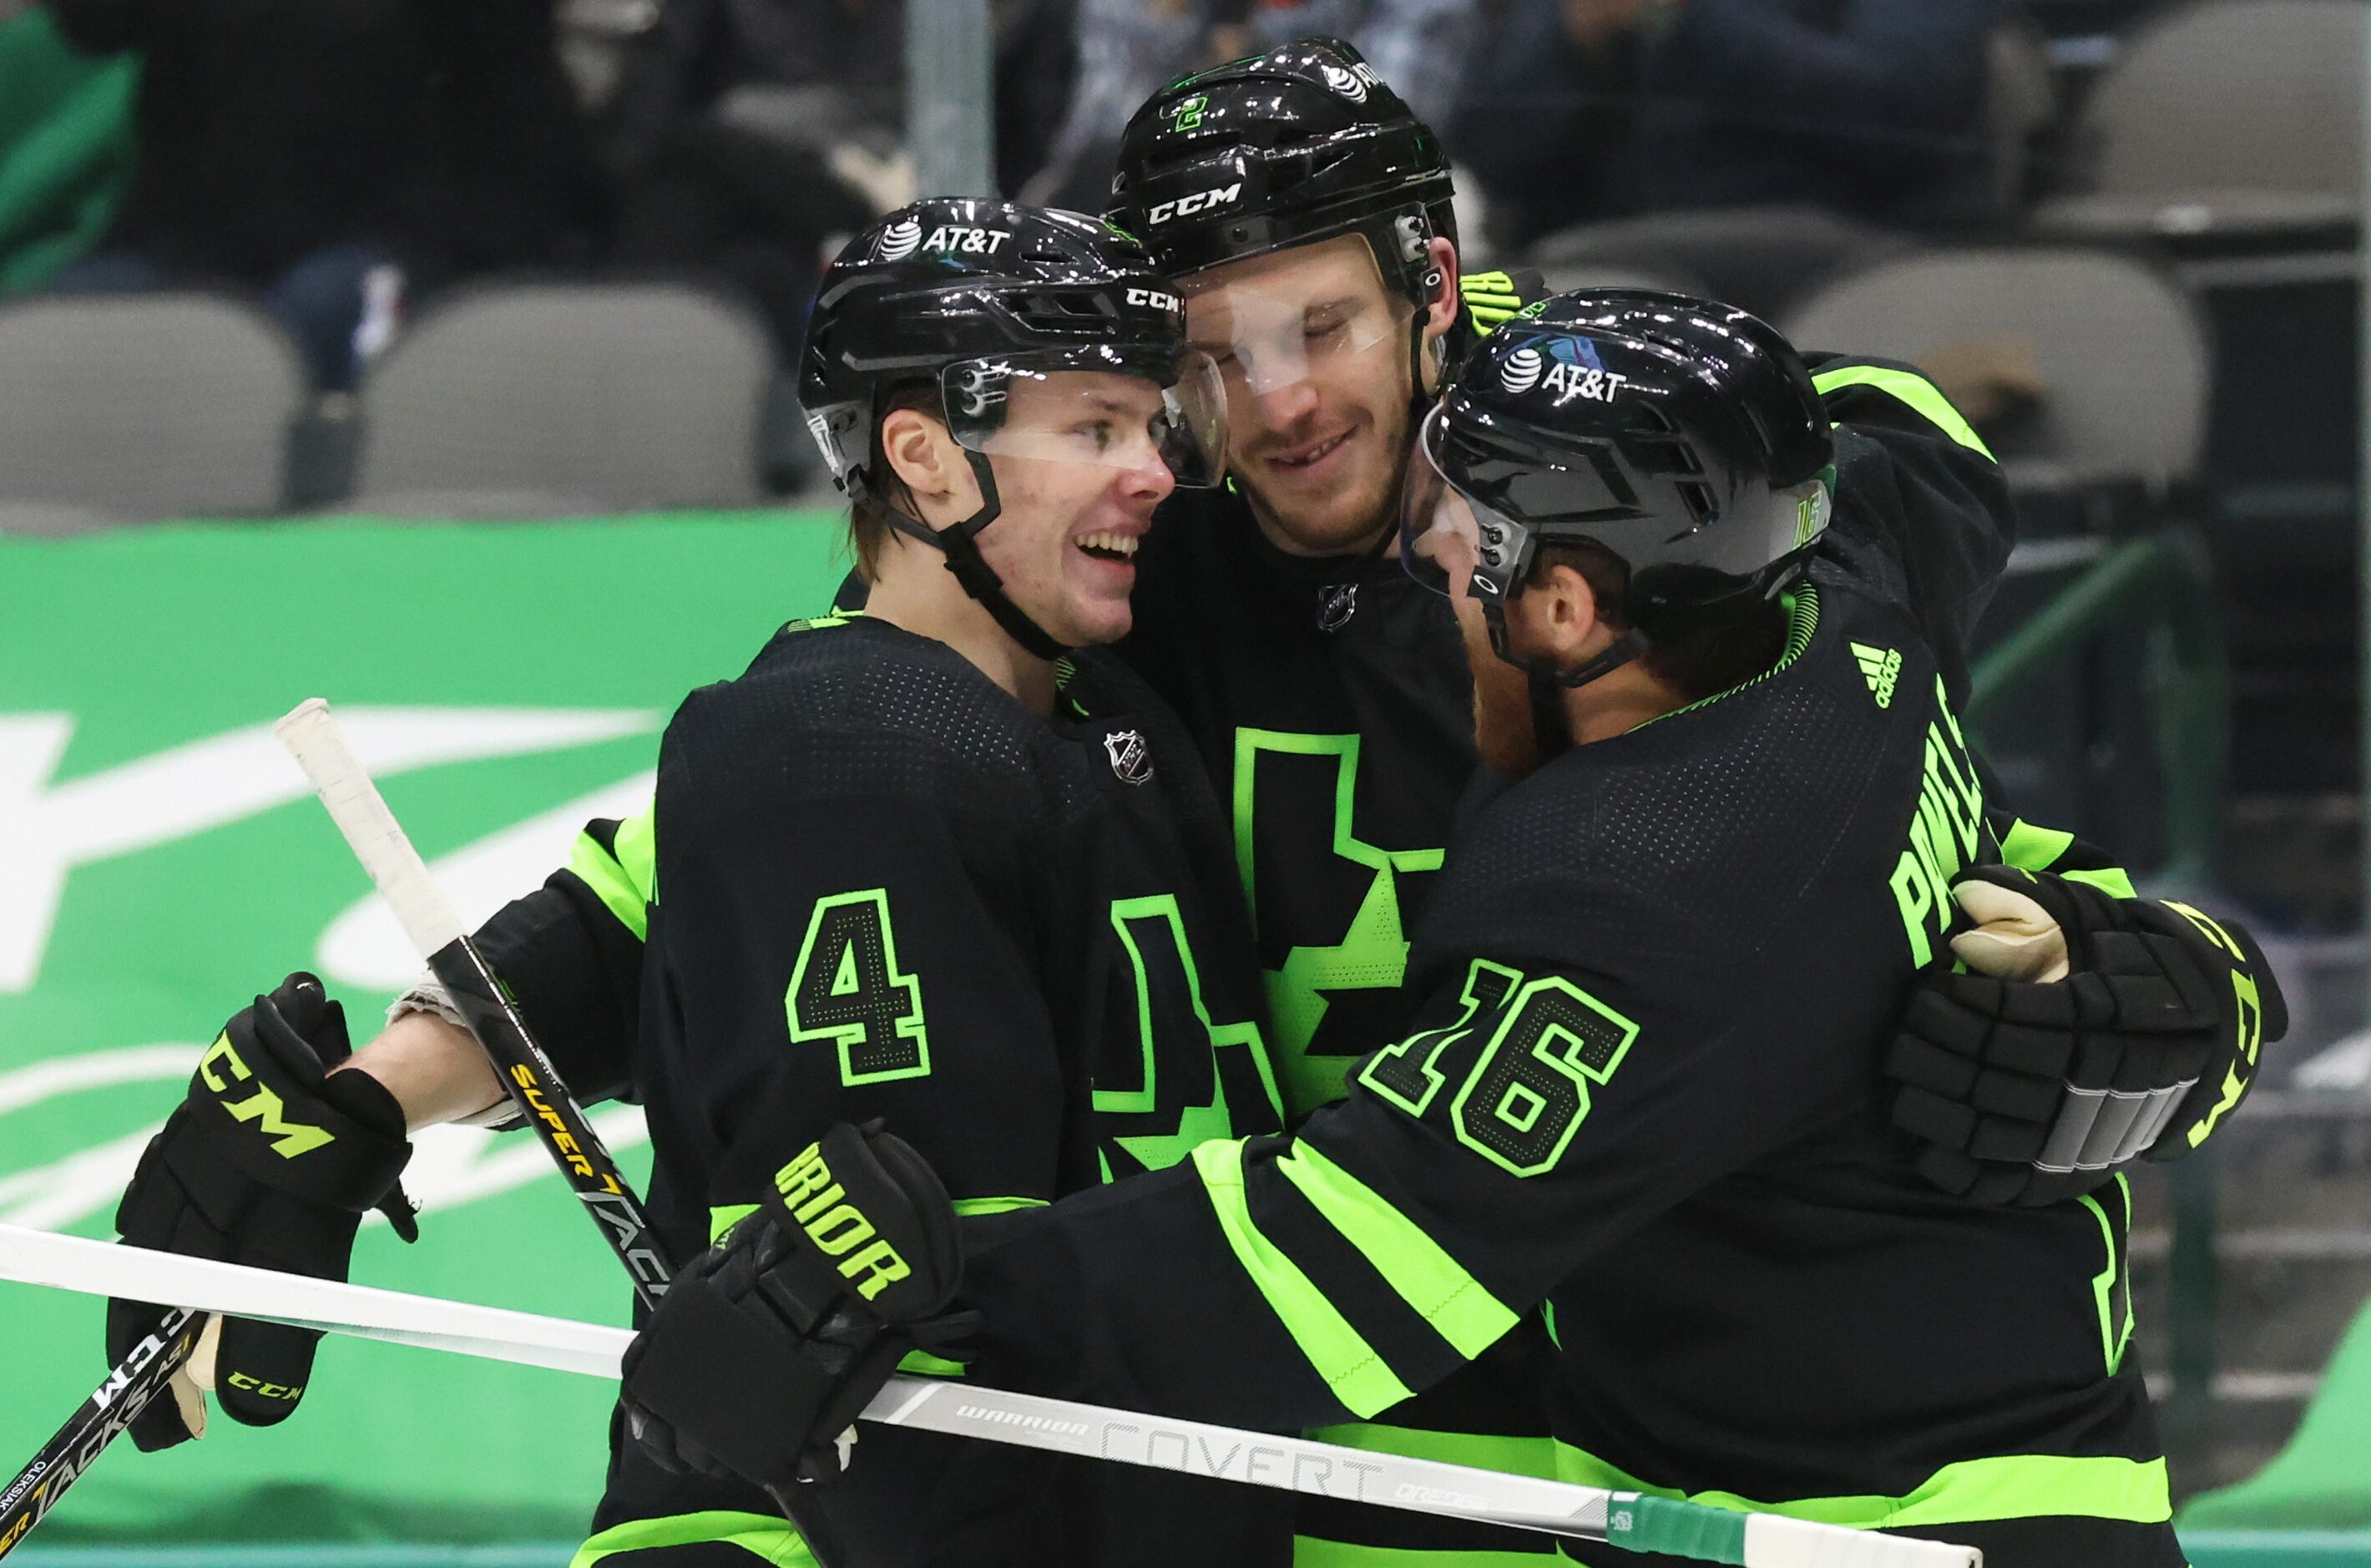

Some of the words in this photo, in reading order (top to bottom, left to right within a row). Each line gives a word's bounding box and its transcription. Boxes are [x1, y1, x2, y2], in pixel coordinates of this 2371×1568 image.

[1175, 97, 1209, 133] 2
[1149, 183, 1242, 225] CCM
[922, 226, 1012, 255] AT&T
[1126, 288, 1179, 313] CCM
[1541, 362, 1627, 403] AT&T
[1792, 490, 1822, 550] 16
[1875, 648, 1903, 709] adidas
[785, 888, 932, 1087] 4
[1357, 958, 1641, 1178] 16
[510, 1064, 594, 1178] SUPER
[92, 1308, 197, 1410] CCM
[228, 1371, 303, 1400] CCM
[956, 1405, 1089, 1436] WARRIOR
[32, 1376, 152, 1523] TACKS
[1100, 1422, 1384, 1502] COVERT
[0, 1461, 47, 1511] OLEKSIAK
